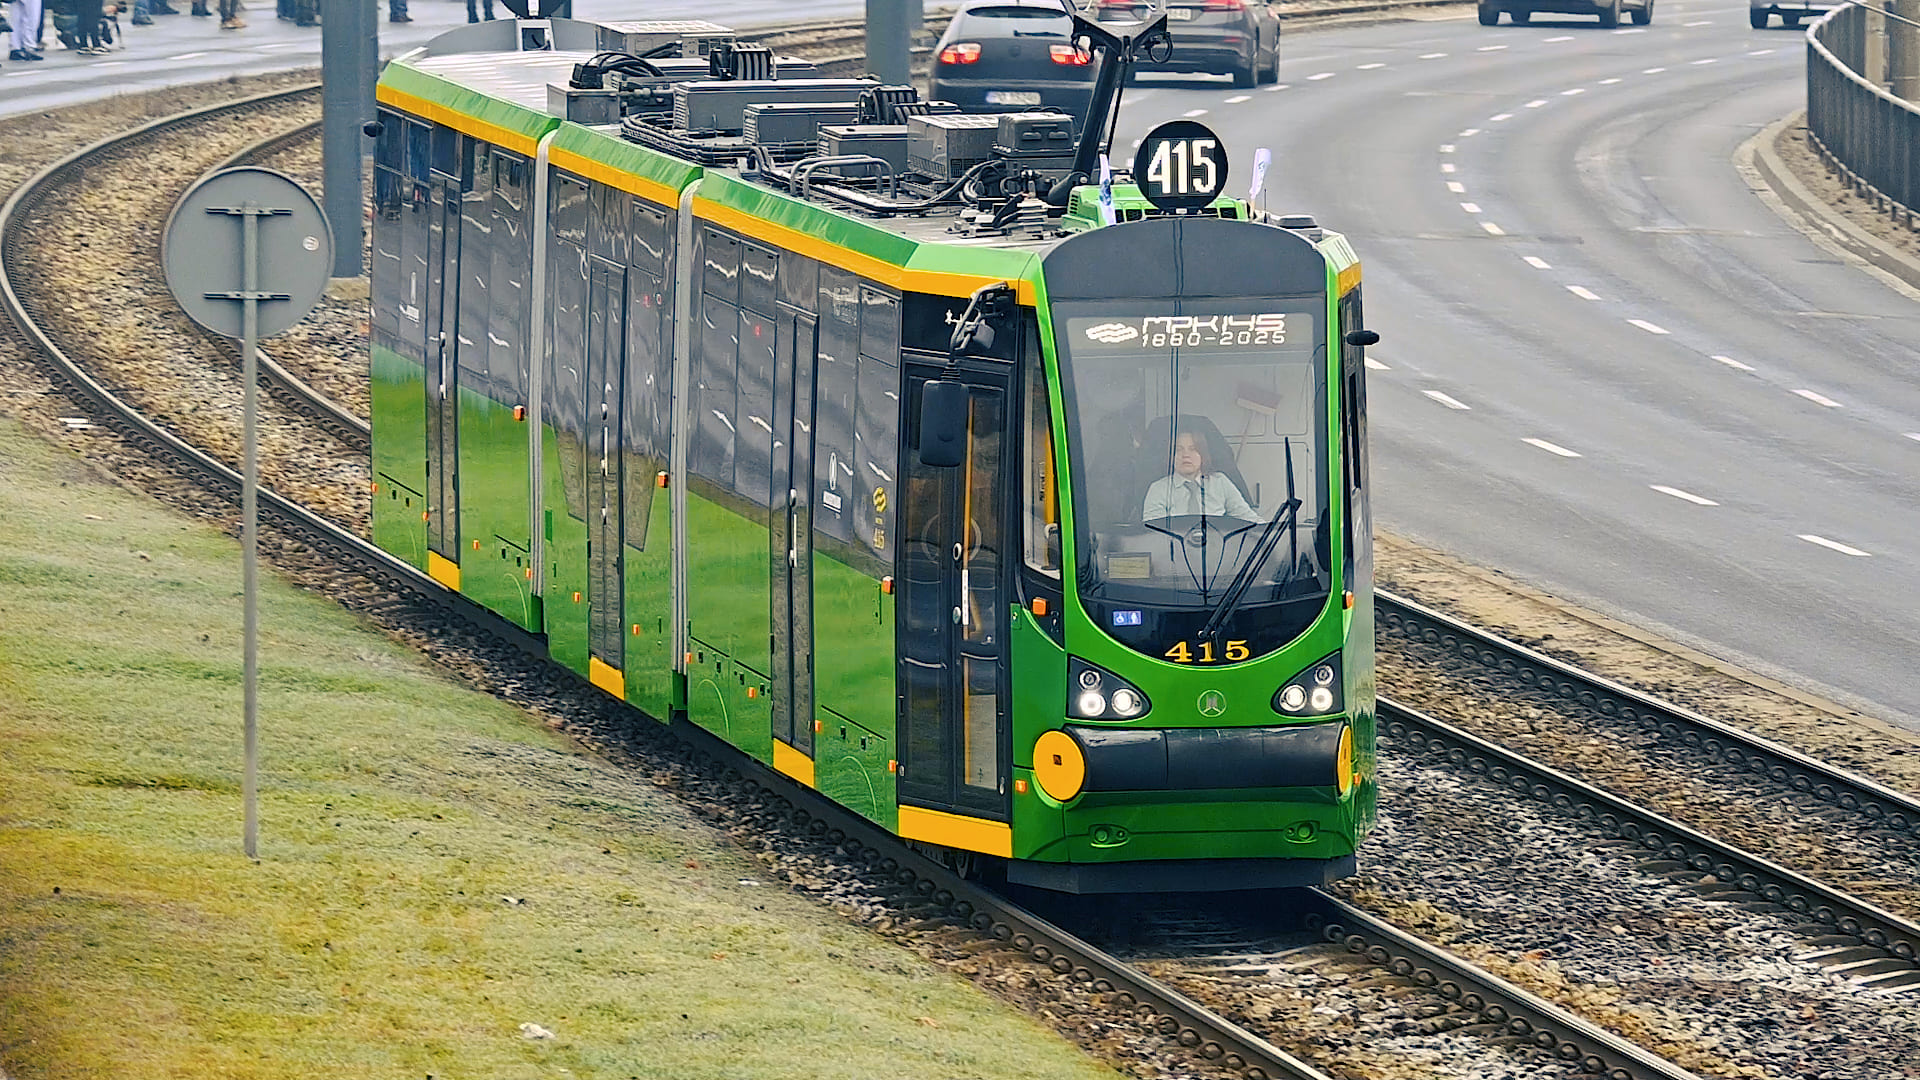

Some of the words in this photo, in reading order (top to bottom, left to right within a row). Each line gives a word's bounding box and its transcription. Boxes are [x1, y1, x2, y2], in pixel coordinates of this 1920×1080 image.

[1147, 140, 1217, 194] 415
[1142, 331, 1286, 347] 1880-2025
[1164, 640, 1250, 663] 415
